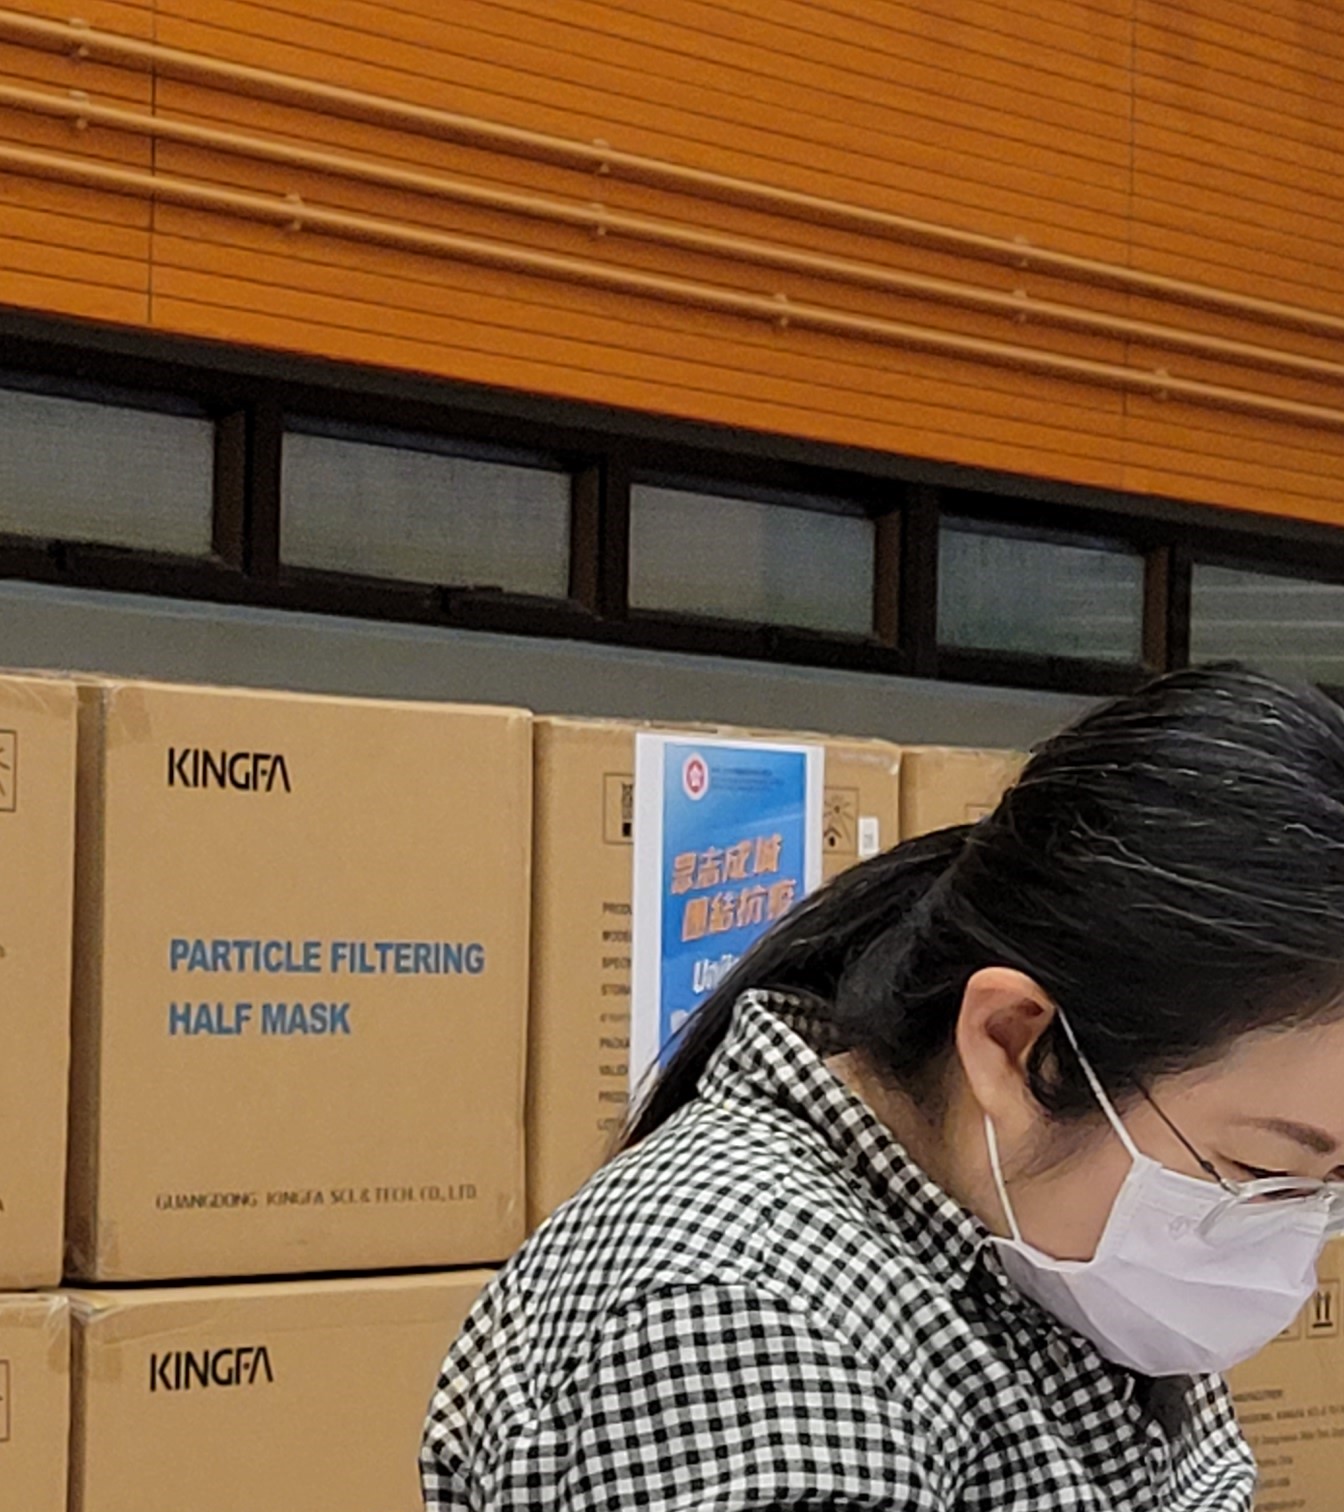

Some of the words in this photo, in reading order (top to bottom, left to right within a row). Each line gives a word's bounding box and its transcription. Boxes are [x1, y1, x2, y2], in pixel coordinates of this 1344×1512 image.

[167, 746, 292, 793] KINGFA
[170, 938, 322, 973] PARTICLE
[330, 942, 485, 975] FILTERING
[168, 1002, 253, 1036] HALF
[261, 1002, 351, 1036] MASK
[155, 1191, 259, 1211] GUANGDONG
[266, 1189, 324, 1207] KINGFA
[150, 1346, 274, 1392] KINGFA
